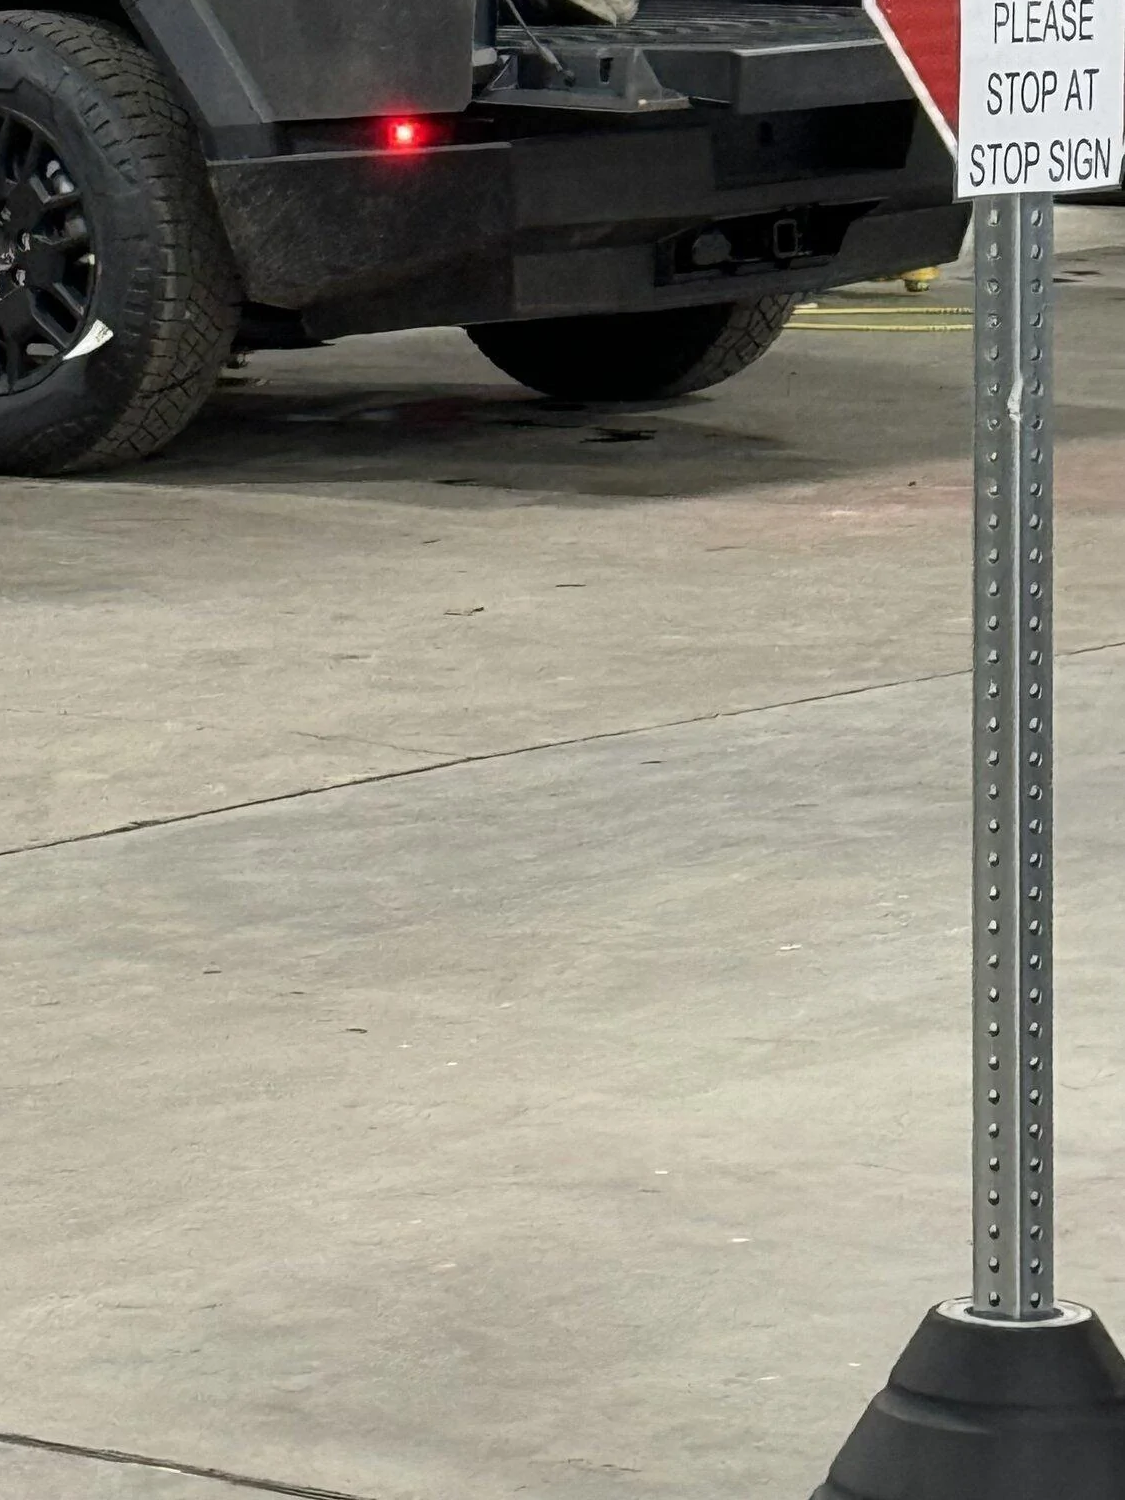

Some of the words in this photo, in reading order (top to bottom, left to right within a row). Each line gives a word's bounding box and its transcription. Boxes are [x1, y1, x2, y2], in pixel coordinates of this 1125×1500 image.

[993, 0, 1095, 44] PLEASE
[986, 70, 1058, 116] STOP
[1064, 67, 1100, 112] AT
[969, 140, 1040, 188] STOP
[1048, 136, 1111, 183] SIGN
